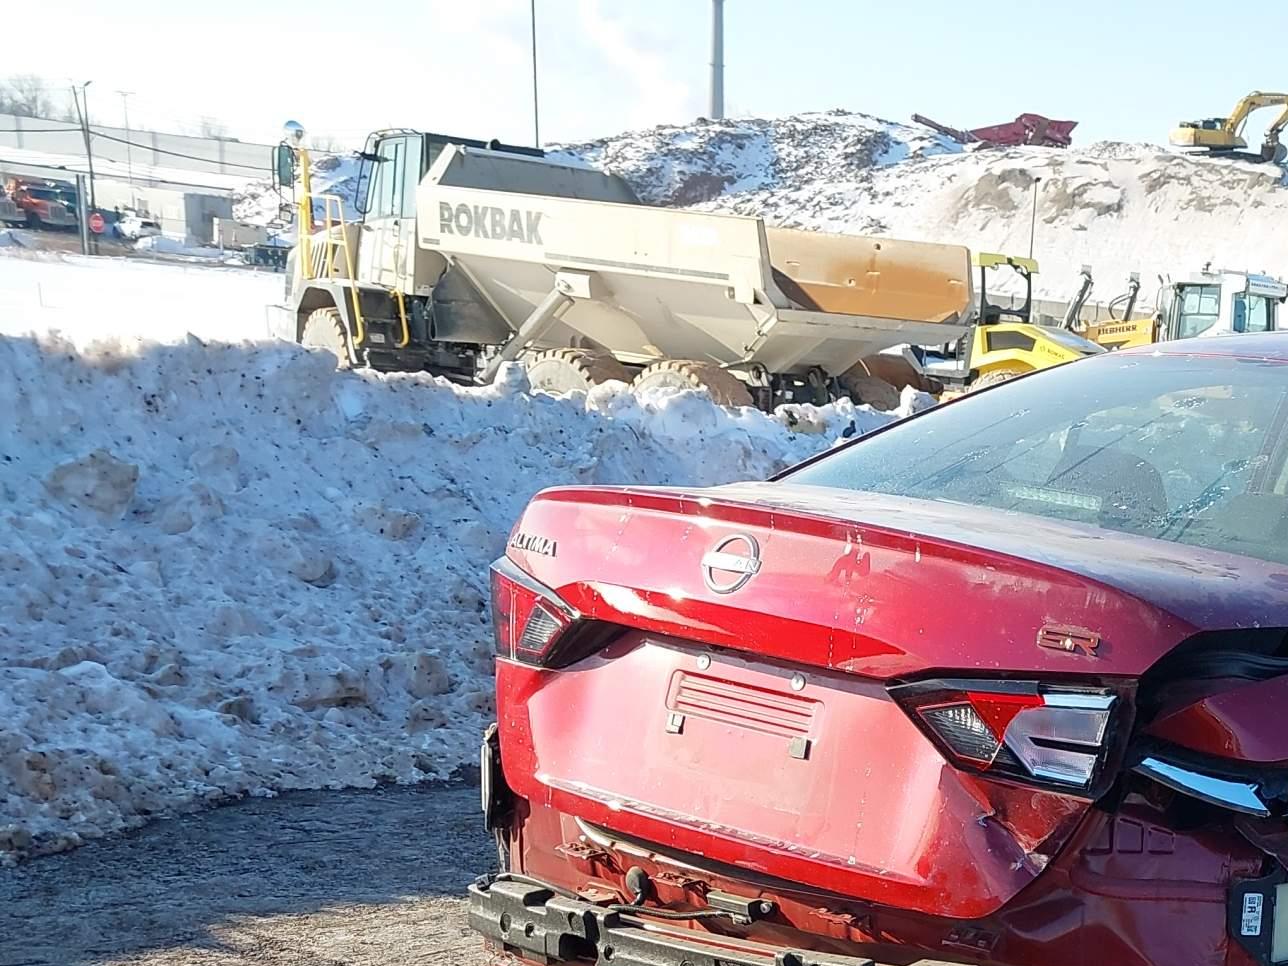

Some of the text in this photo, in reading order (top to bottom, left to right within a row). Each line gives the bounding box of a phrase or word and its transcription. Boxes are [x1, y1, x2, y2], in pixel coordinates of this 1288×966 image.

[439, 201, 544, 246] ROKBAK
[510, 532, 558, 557] ALTIMA
[1037, 625, 1099, 656] SR
